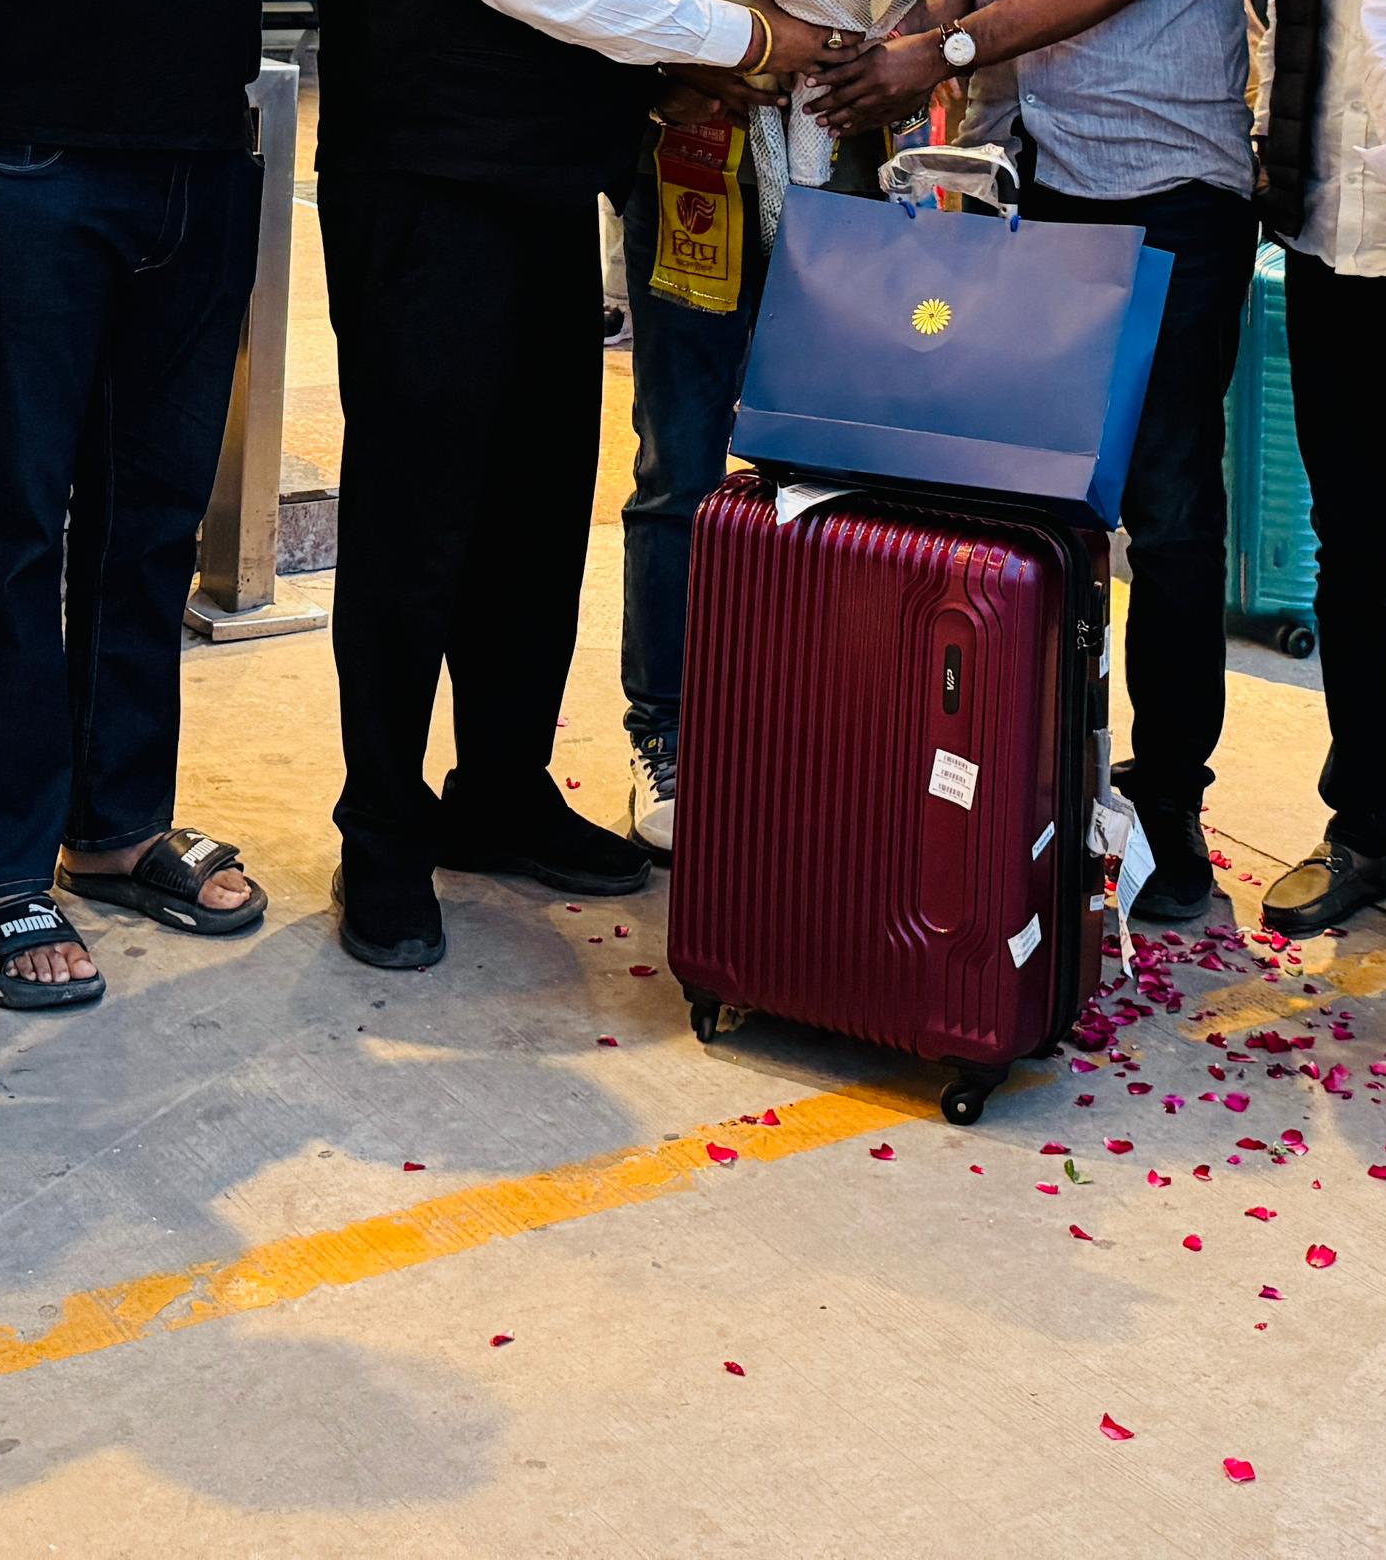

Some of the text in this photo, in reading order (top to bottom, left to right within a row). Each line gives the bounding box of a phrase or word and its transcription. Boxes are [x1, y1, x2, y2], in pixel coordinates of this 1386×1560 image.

[947, 668, 955, 691] VIP
[181, 838, 220, 868] PUMA
[0, 914, 58, 939] PUMA
